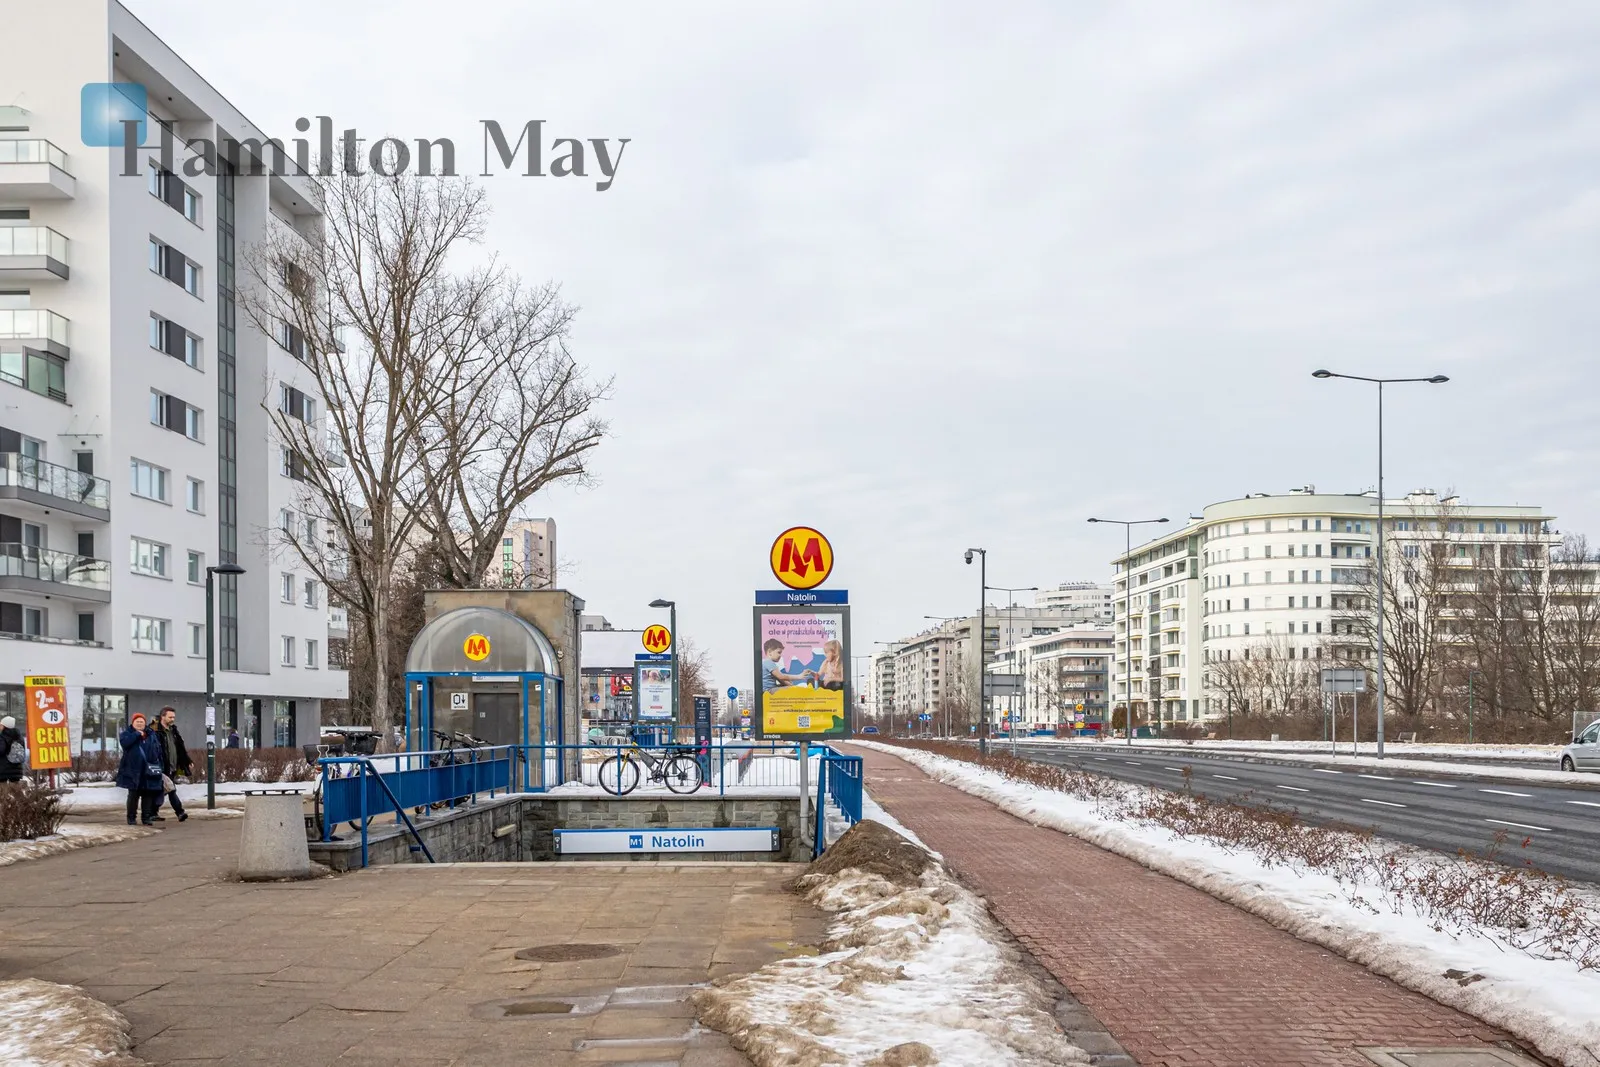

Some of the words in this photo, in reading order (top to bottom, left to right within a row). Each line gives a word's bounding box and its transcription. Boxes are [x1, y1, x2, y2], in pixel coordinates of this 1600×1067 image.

[787, 593, 817, 601] Natolin
[768, 618, 807, 627] Wszędzie
[807, 618, 837, 626] dobrze,
[35, 689, 49, 709] 2
[49, 711, 59, 722] 79
[36, 727, 69, 744] CENA
[39, 746, 70, 763] DNIA
[630, 837, 643, 847] M1
[652, 835, 705, 848] Natolin
